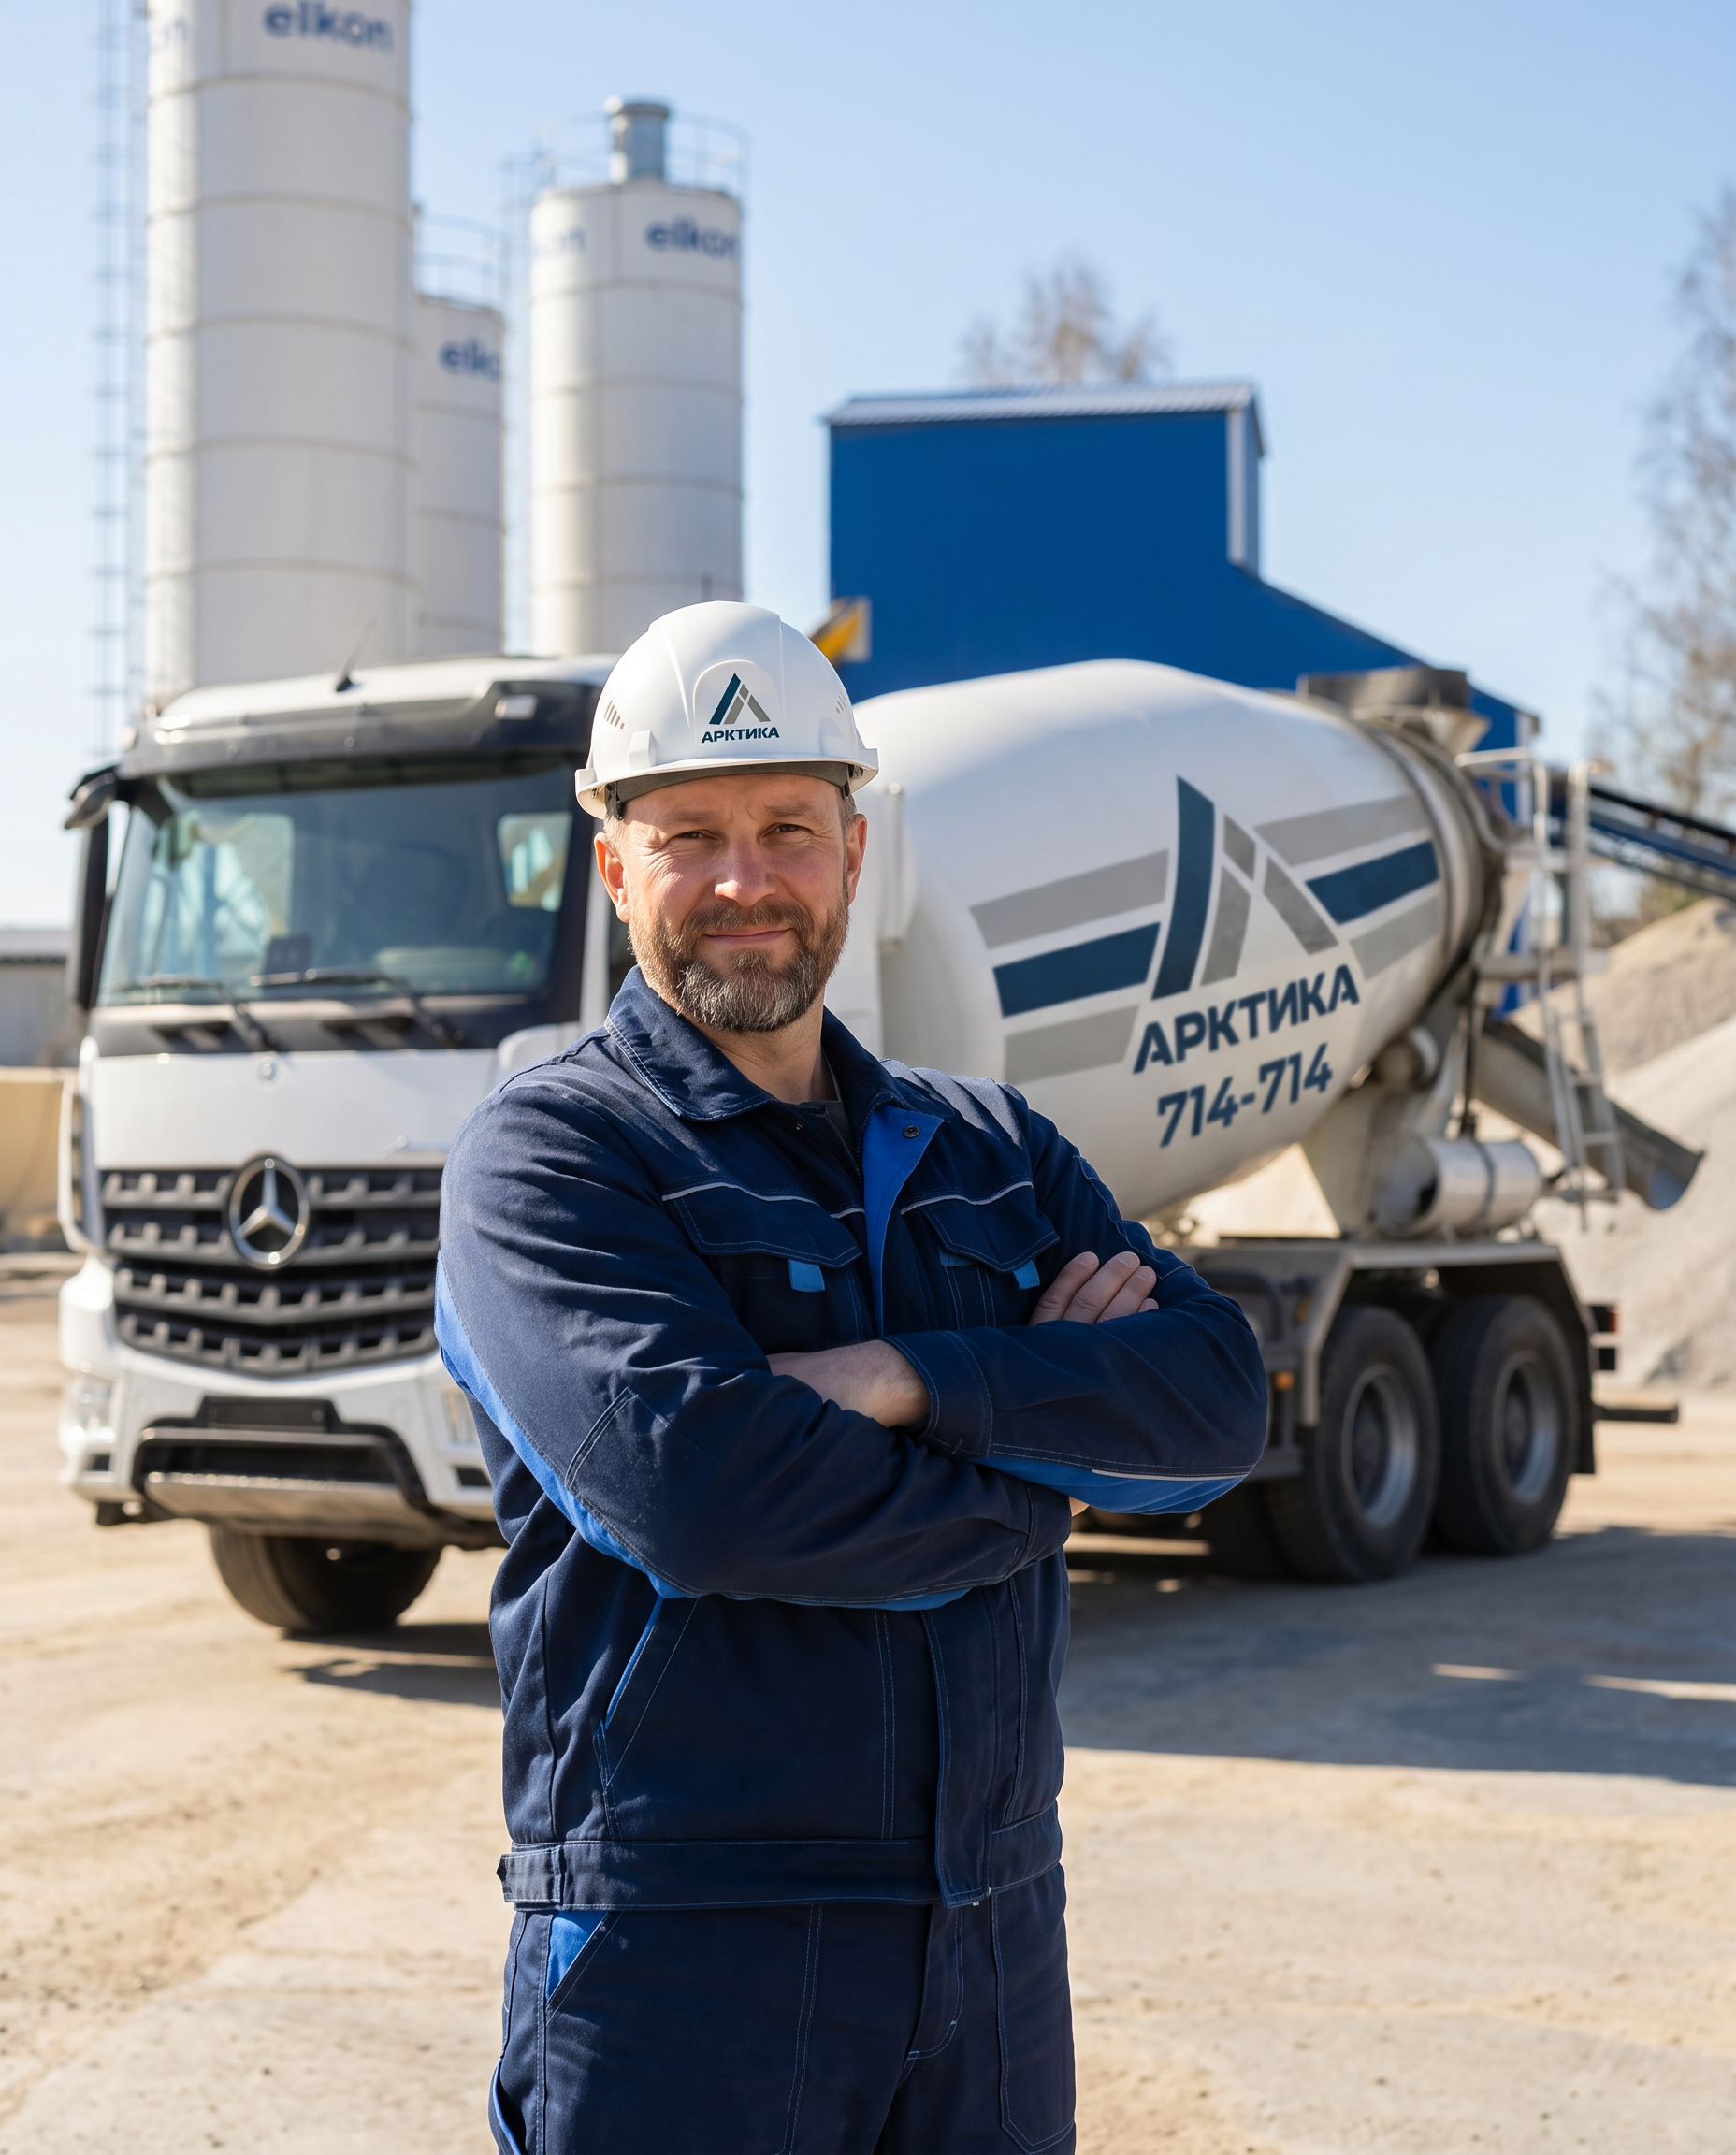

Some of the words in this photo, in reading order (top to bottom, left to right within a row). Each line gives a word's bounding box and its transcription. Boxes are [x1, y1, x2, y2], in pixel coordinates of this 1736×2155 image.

[265, 0, 395, 53] elkon
[701, 727, 780, 744] АРКТИКА
[1133, 963, 1360, 1075] АРКТИКА
[1157, 1042, 1333, 1149] 714-714
